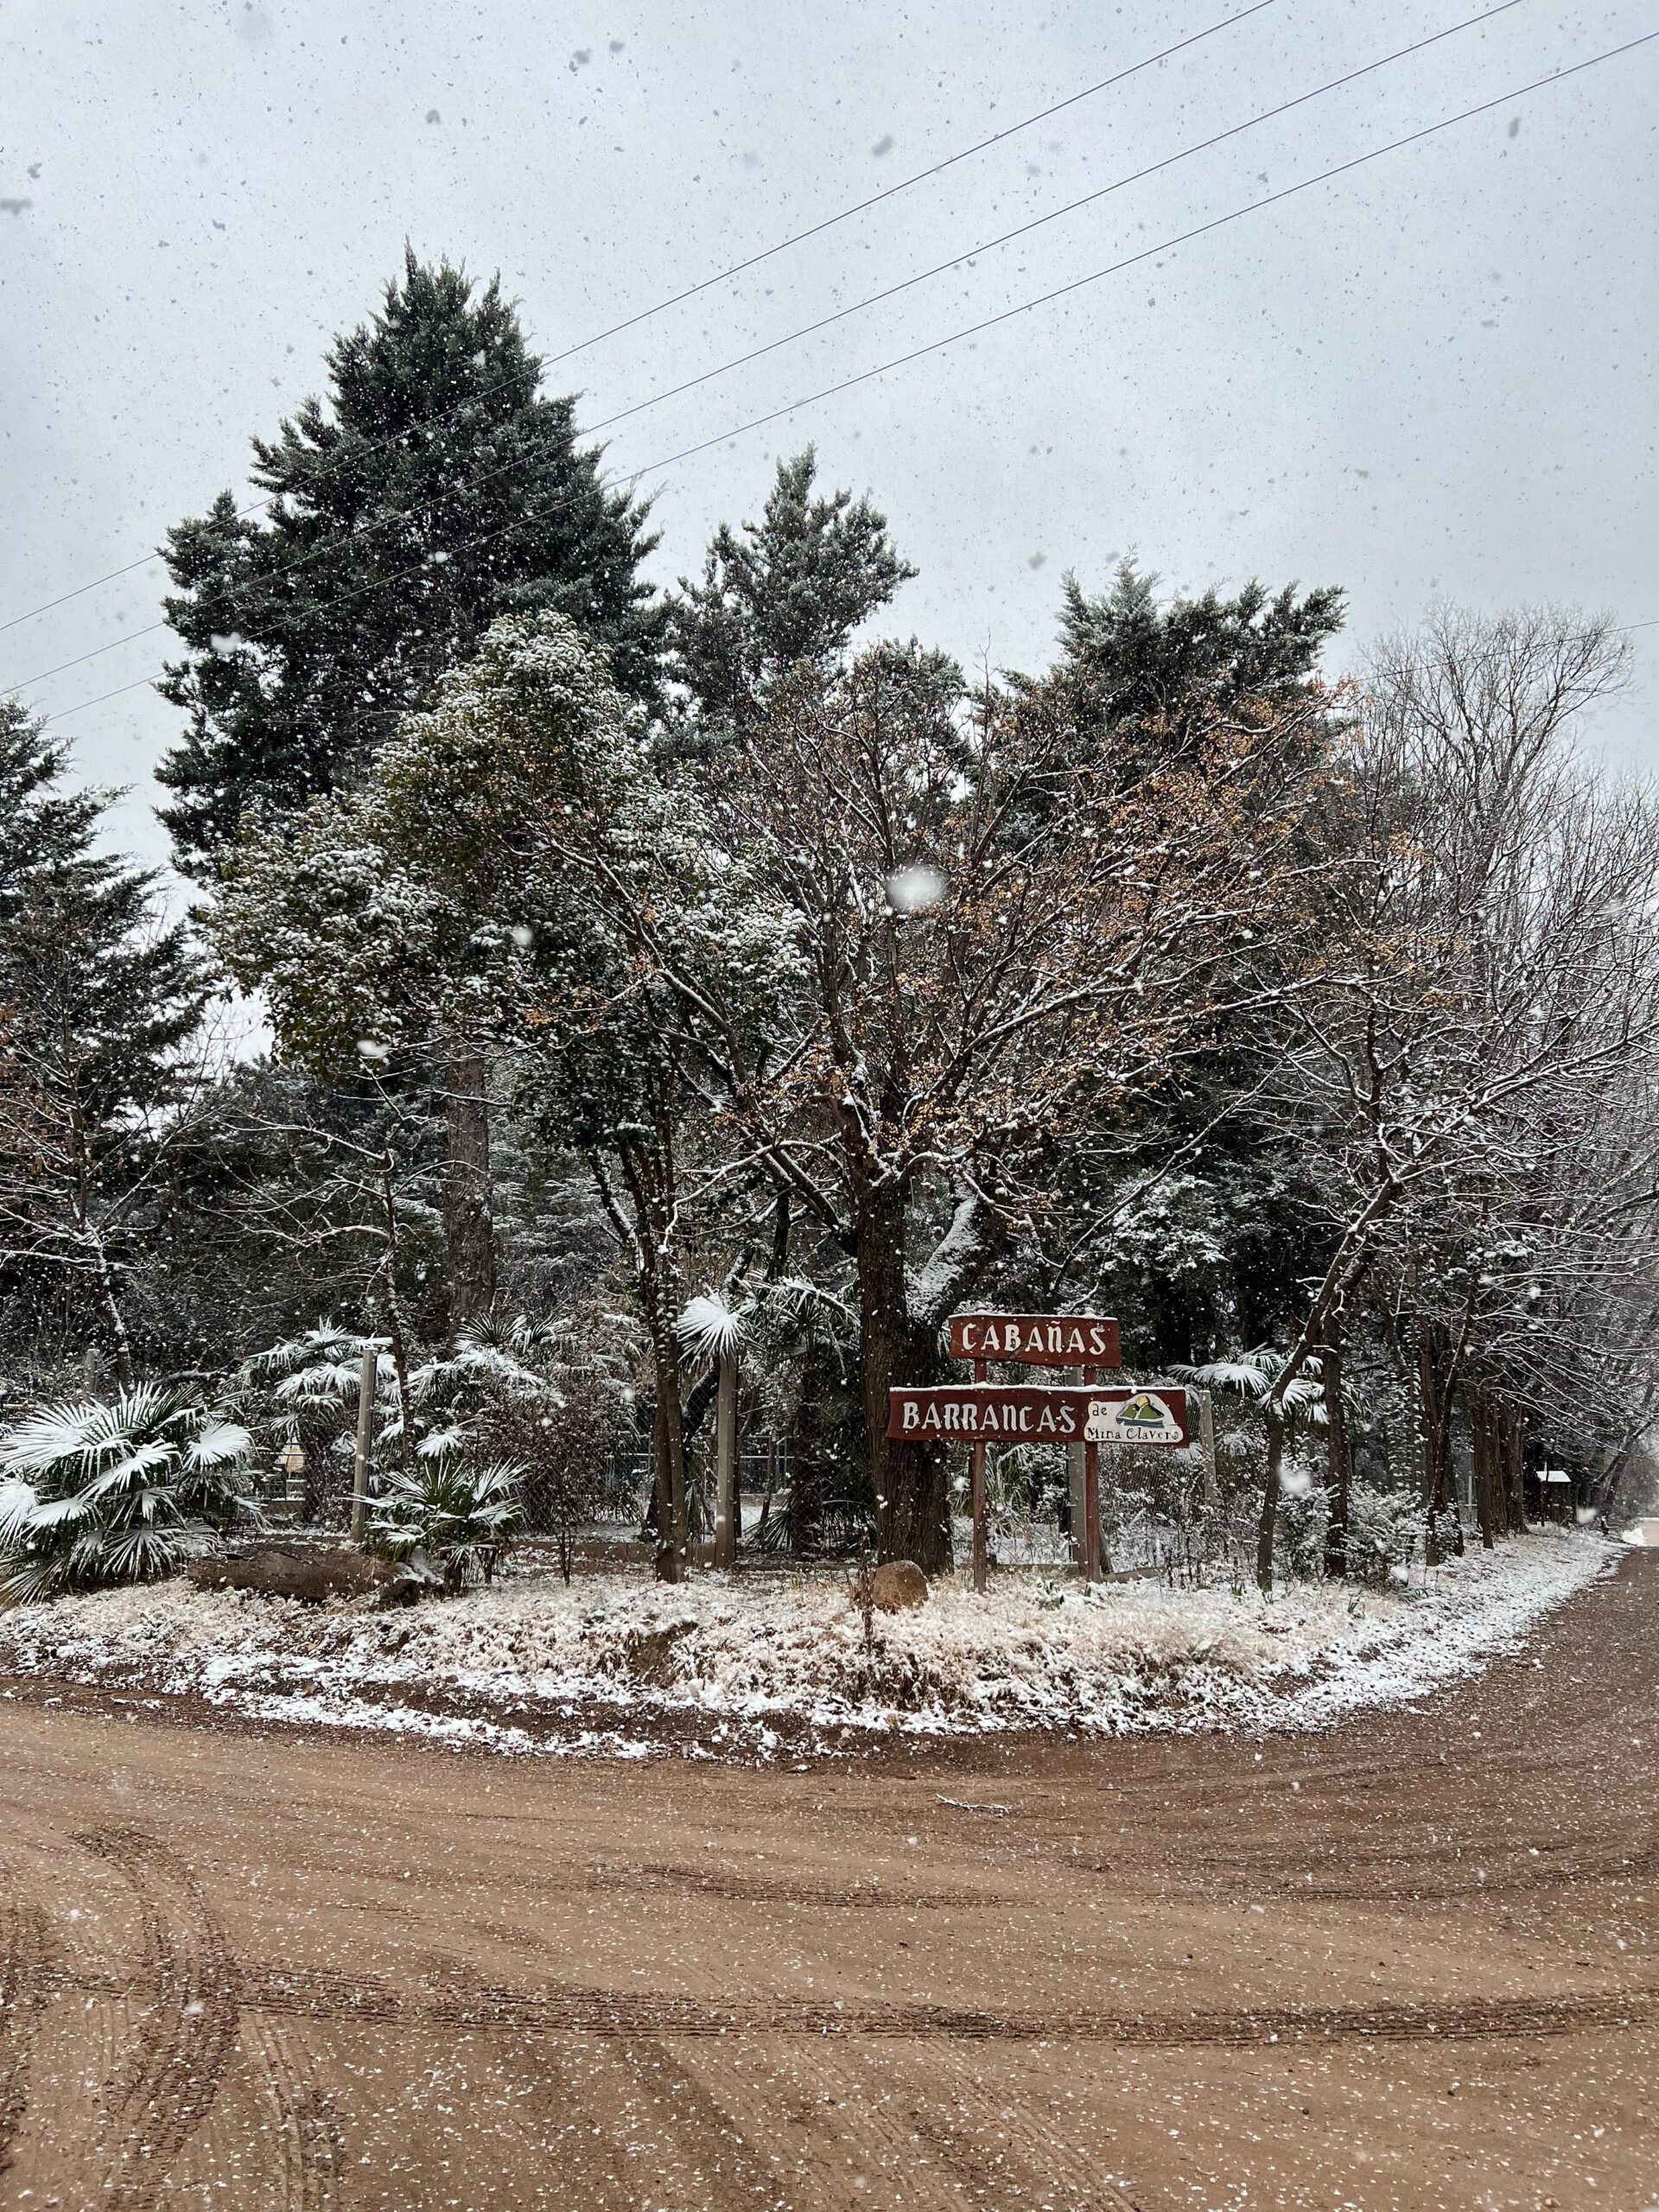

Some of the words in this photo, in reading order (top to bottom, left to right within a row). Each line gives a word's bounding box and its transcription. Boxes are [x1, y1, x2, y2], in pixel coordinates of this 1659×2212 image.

[961, 1321, 1107, 1356] CABAÑAS
[902, 1402, 1077, 1433] BARRANCAS
[1092, 1403, 1108, 1416] de
[1087, 1427, 1122, 1440] Mina
[1126, 1427, 1179, 1440] Clavero
